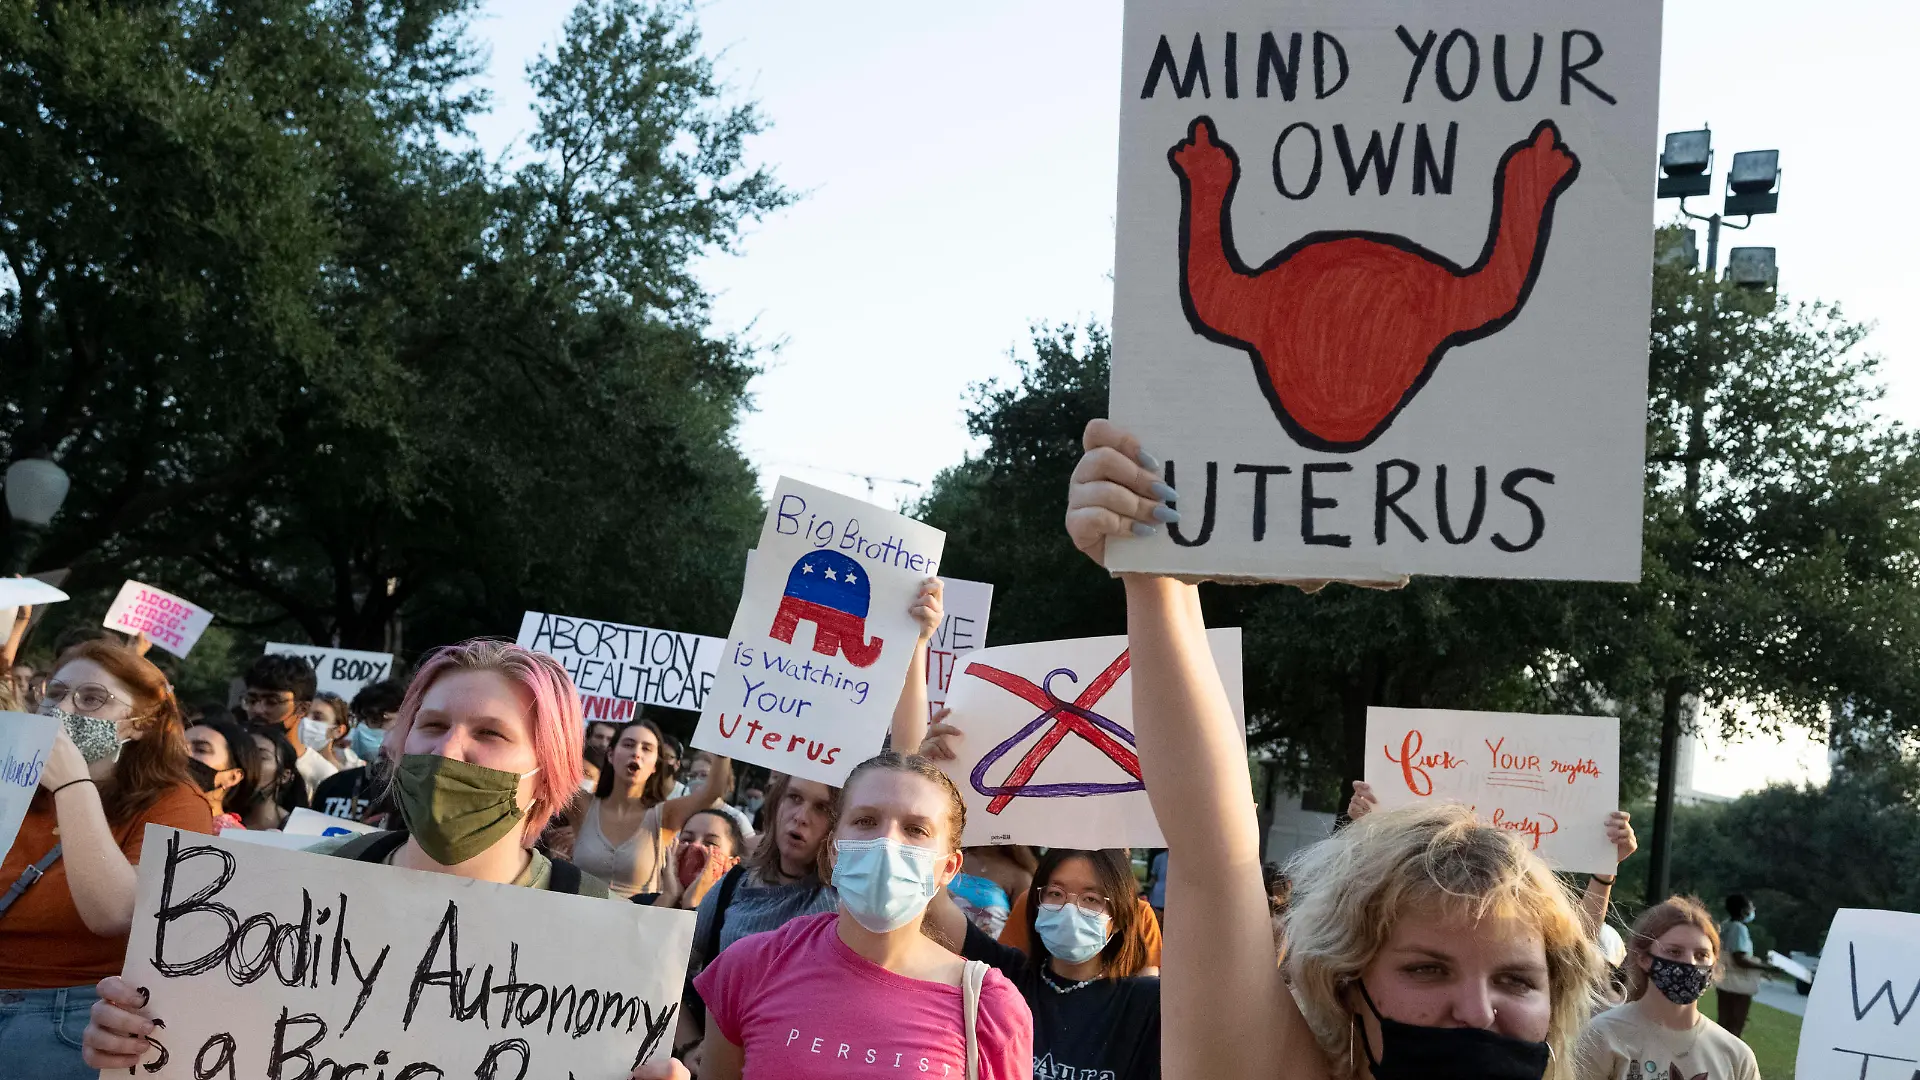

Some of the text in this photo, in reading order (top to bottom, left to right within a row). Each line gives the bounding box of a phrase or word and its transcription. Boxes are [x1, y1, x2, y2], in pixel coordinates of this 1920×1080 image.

[1141, 25, 1617, 105] MIND YOUR
[1272, 121, 1458, 200] OWN
[1162, 459, 1555, 553] UTERUS
[776, 494, 937, 574] Big Brother
[136, 589, 193, 620] ABORT
[531, 612, 701, 674] ABORTION
[734, 641, 754, 667] is
[331, 657, 388, 682] BODY
[742, 674, 812, 718] Your
[719, 712, 841, 766] Uterus
[1550, 758, 1604, 785] rights
[324, 796, 369, 819] THE
[1492, 808, 1559, 850] body
[149, 829, 678, 1079] Bodily Autonomy
[786, 1028, 951, 1078] PERSIST
